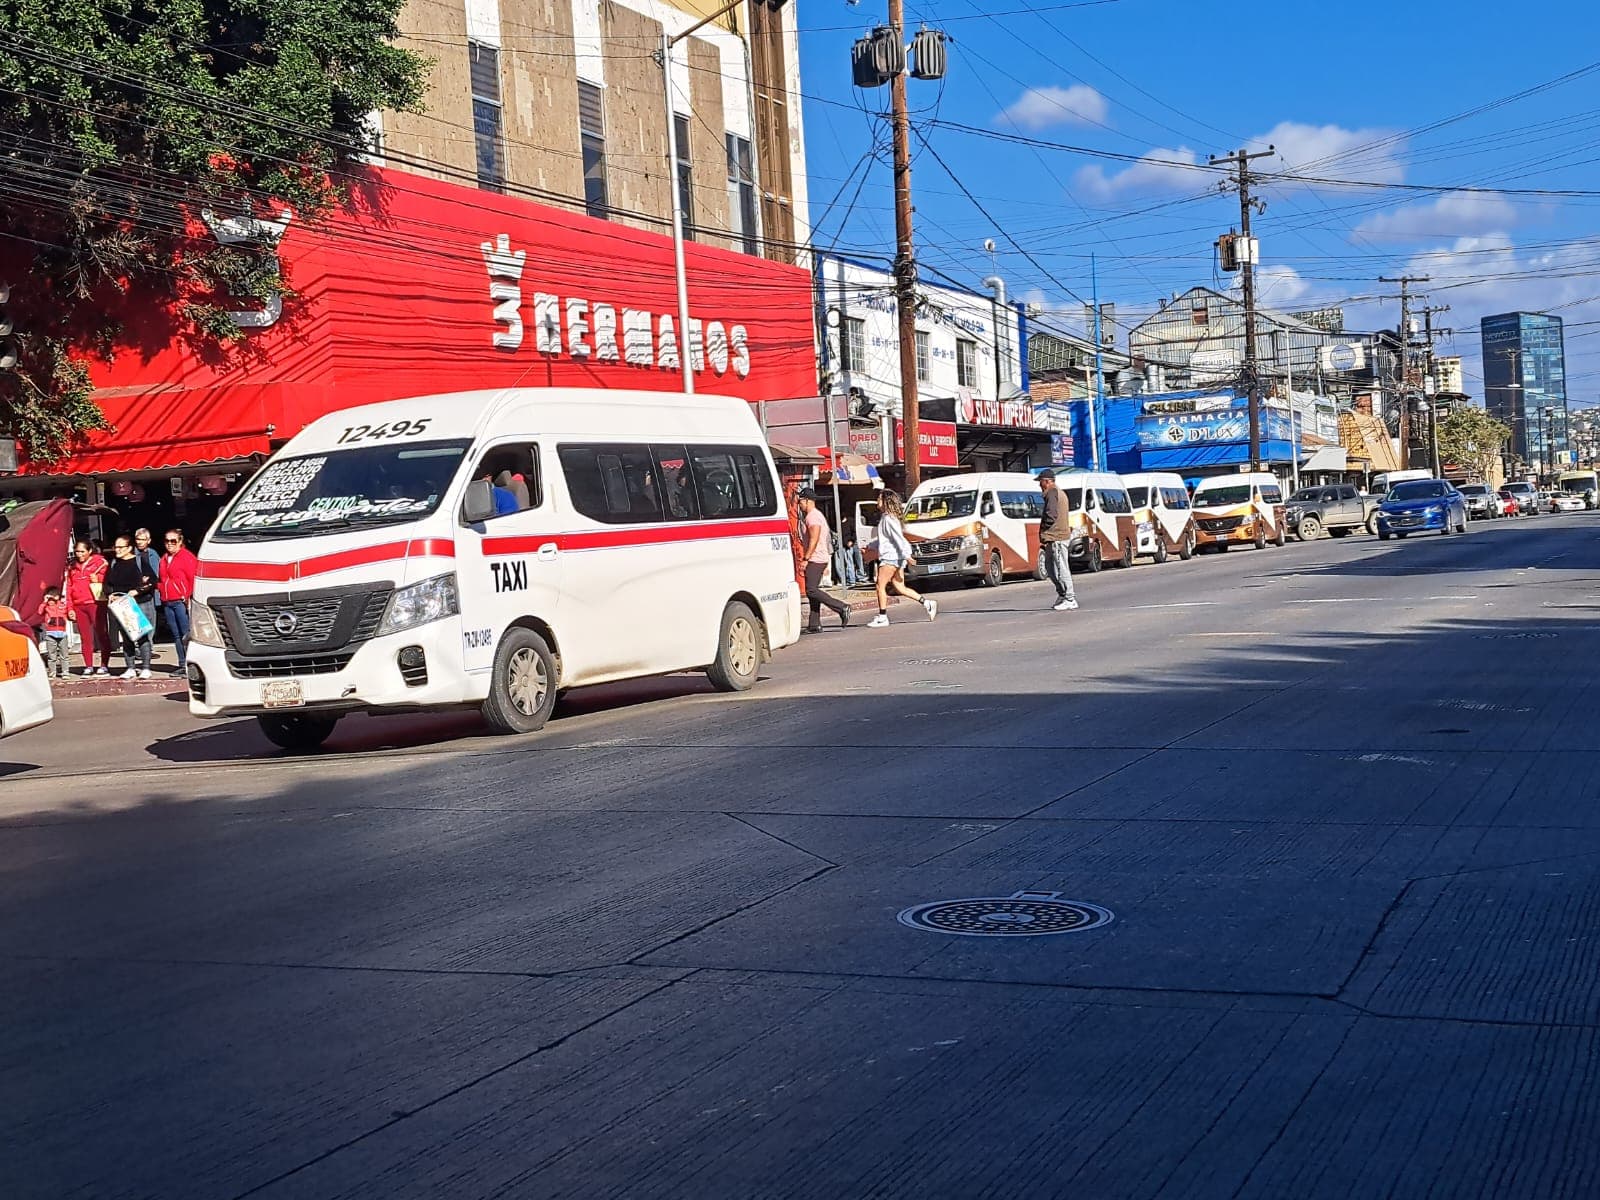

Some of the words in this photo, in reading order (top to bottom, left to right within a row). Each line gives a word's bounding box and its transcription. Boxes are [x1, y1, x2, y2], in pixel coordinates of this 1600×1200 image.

[490, 282, 523, 350] 3
[533, 292, 750, 378] HERMANOS
[975, 400, 1000, 425] SUSHI
[1158, 411, 1245, 425] FARMACIA
[337, 418, 432, 444] 12495
[264, 465, 322, 478] MACLOVIO
[257, 473, 315, 486] REFUGIO
[242, 490, 301, 503] AZTECA
[307, 496, 356, 512] CENTRO
[235, 499, 296, 512] INSURGENTES
[491, 560, 528, 593] TAXI
